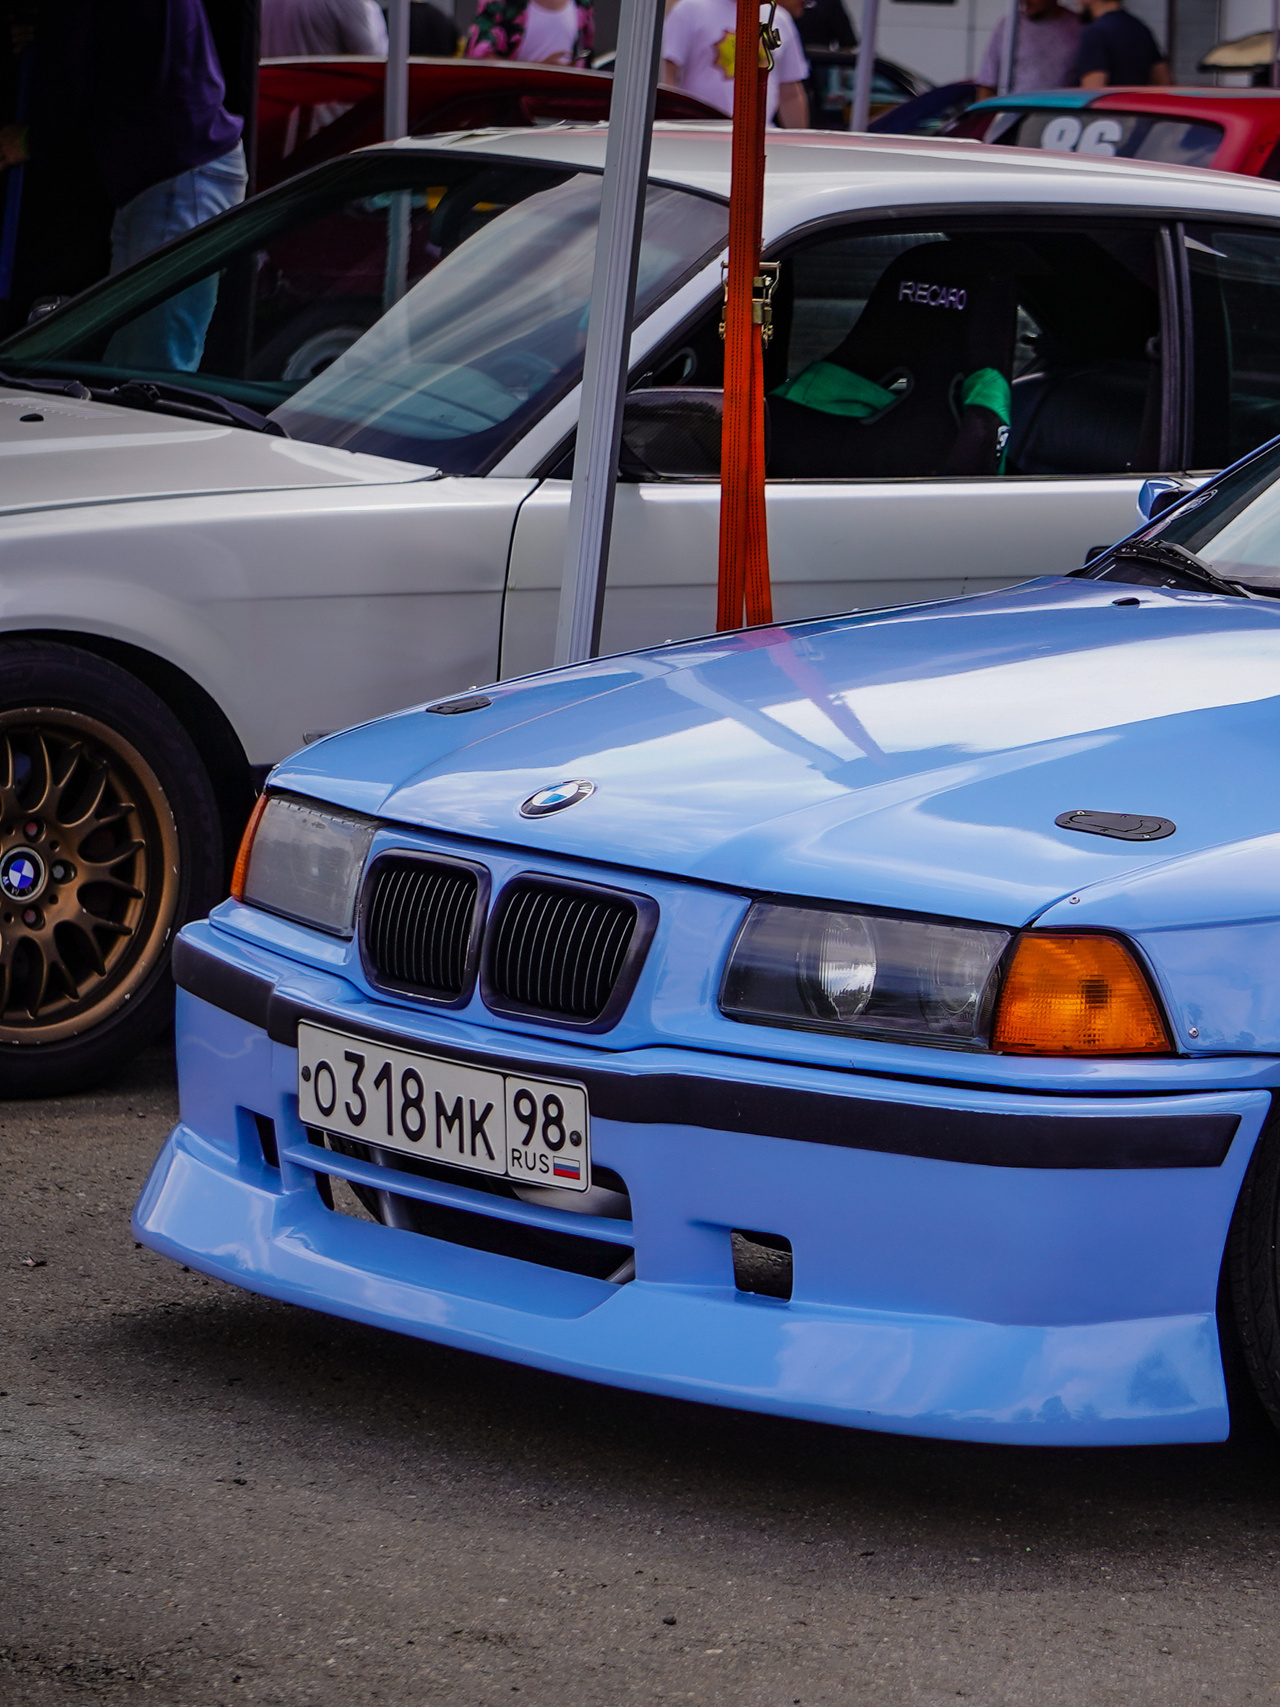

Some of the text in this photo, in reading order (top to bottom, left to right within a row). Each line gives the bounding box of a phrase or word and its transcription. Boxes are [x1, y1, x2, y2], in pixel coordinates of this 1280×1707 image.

[899, 282, 967, 310] RECARO
[513, 1088, 567, 1152] 98
[511, 1148, 550, 1174] RUS
